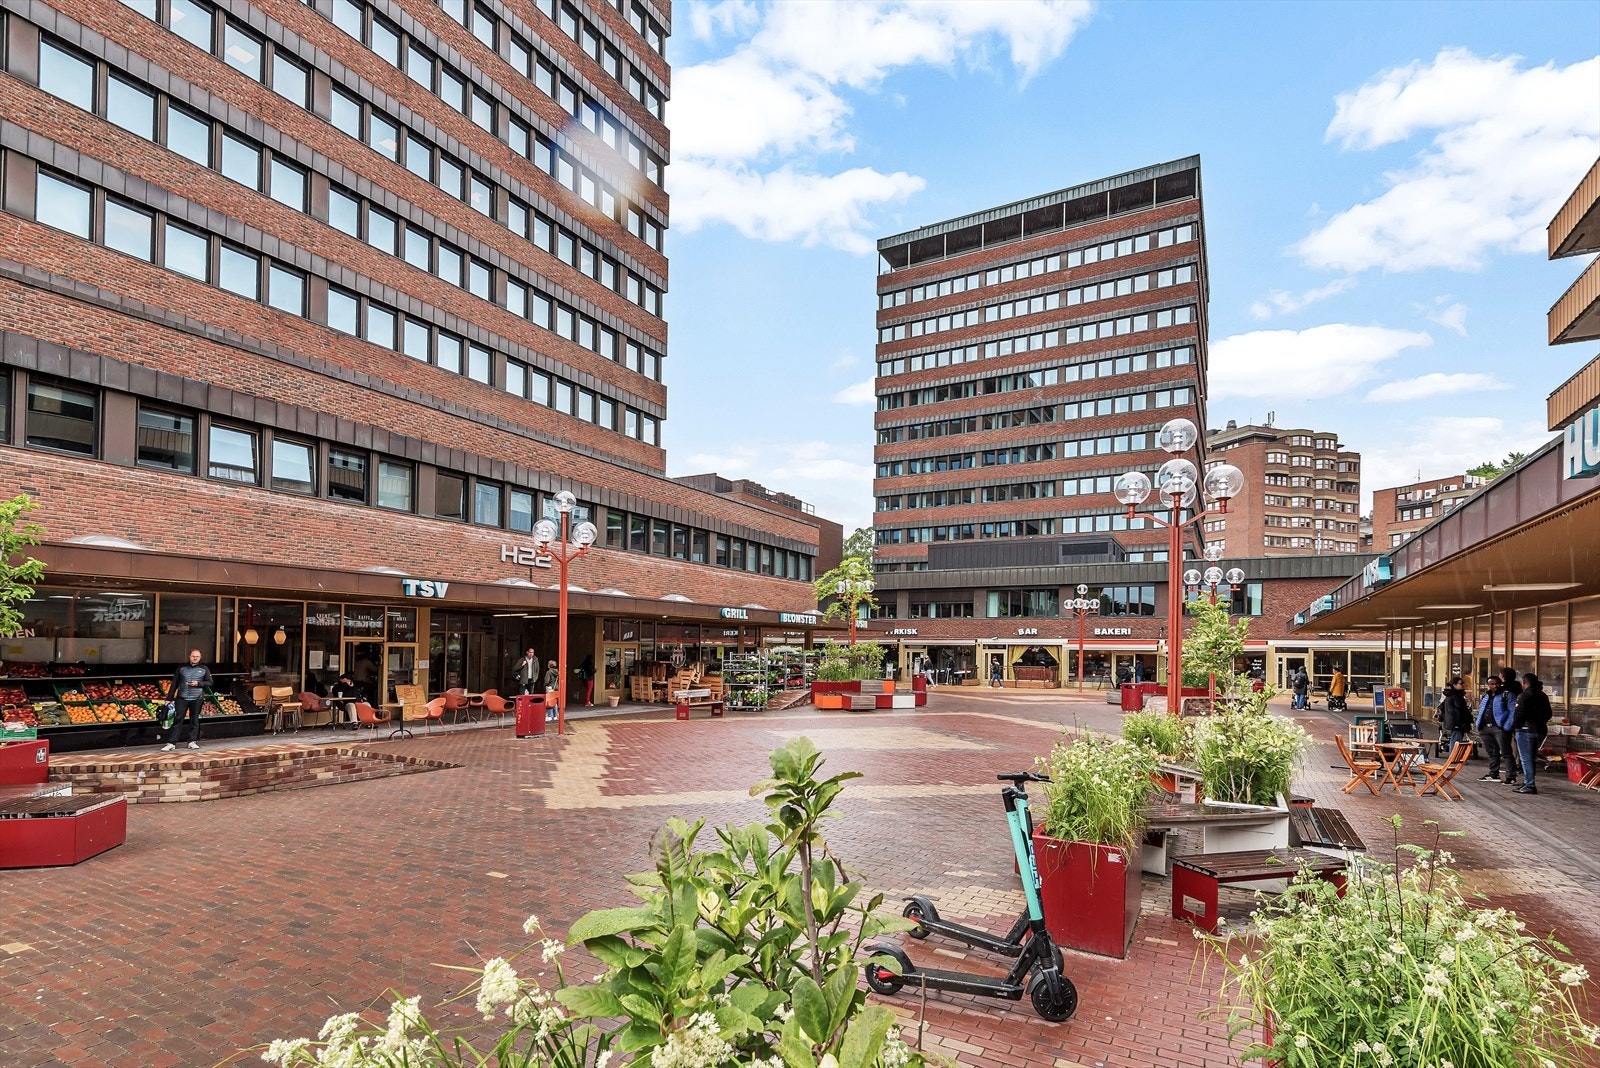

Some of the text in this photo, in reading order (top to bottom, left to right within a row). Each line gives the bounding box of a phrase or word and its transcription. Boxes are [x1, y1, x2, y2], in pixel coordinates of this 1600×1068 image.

[501, 544, 552, 568] H22
[402, 579, 449, 598] TSV
[722, 608, 748, 619] GRILL
[780, 613, 816, 624] BLOMSTER
